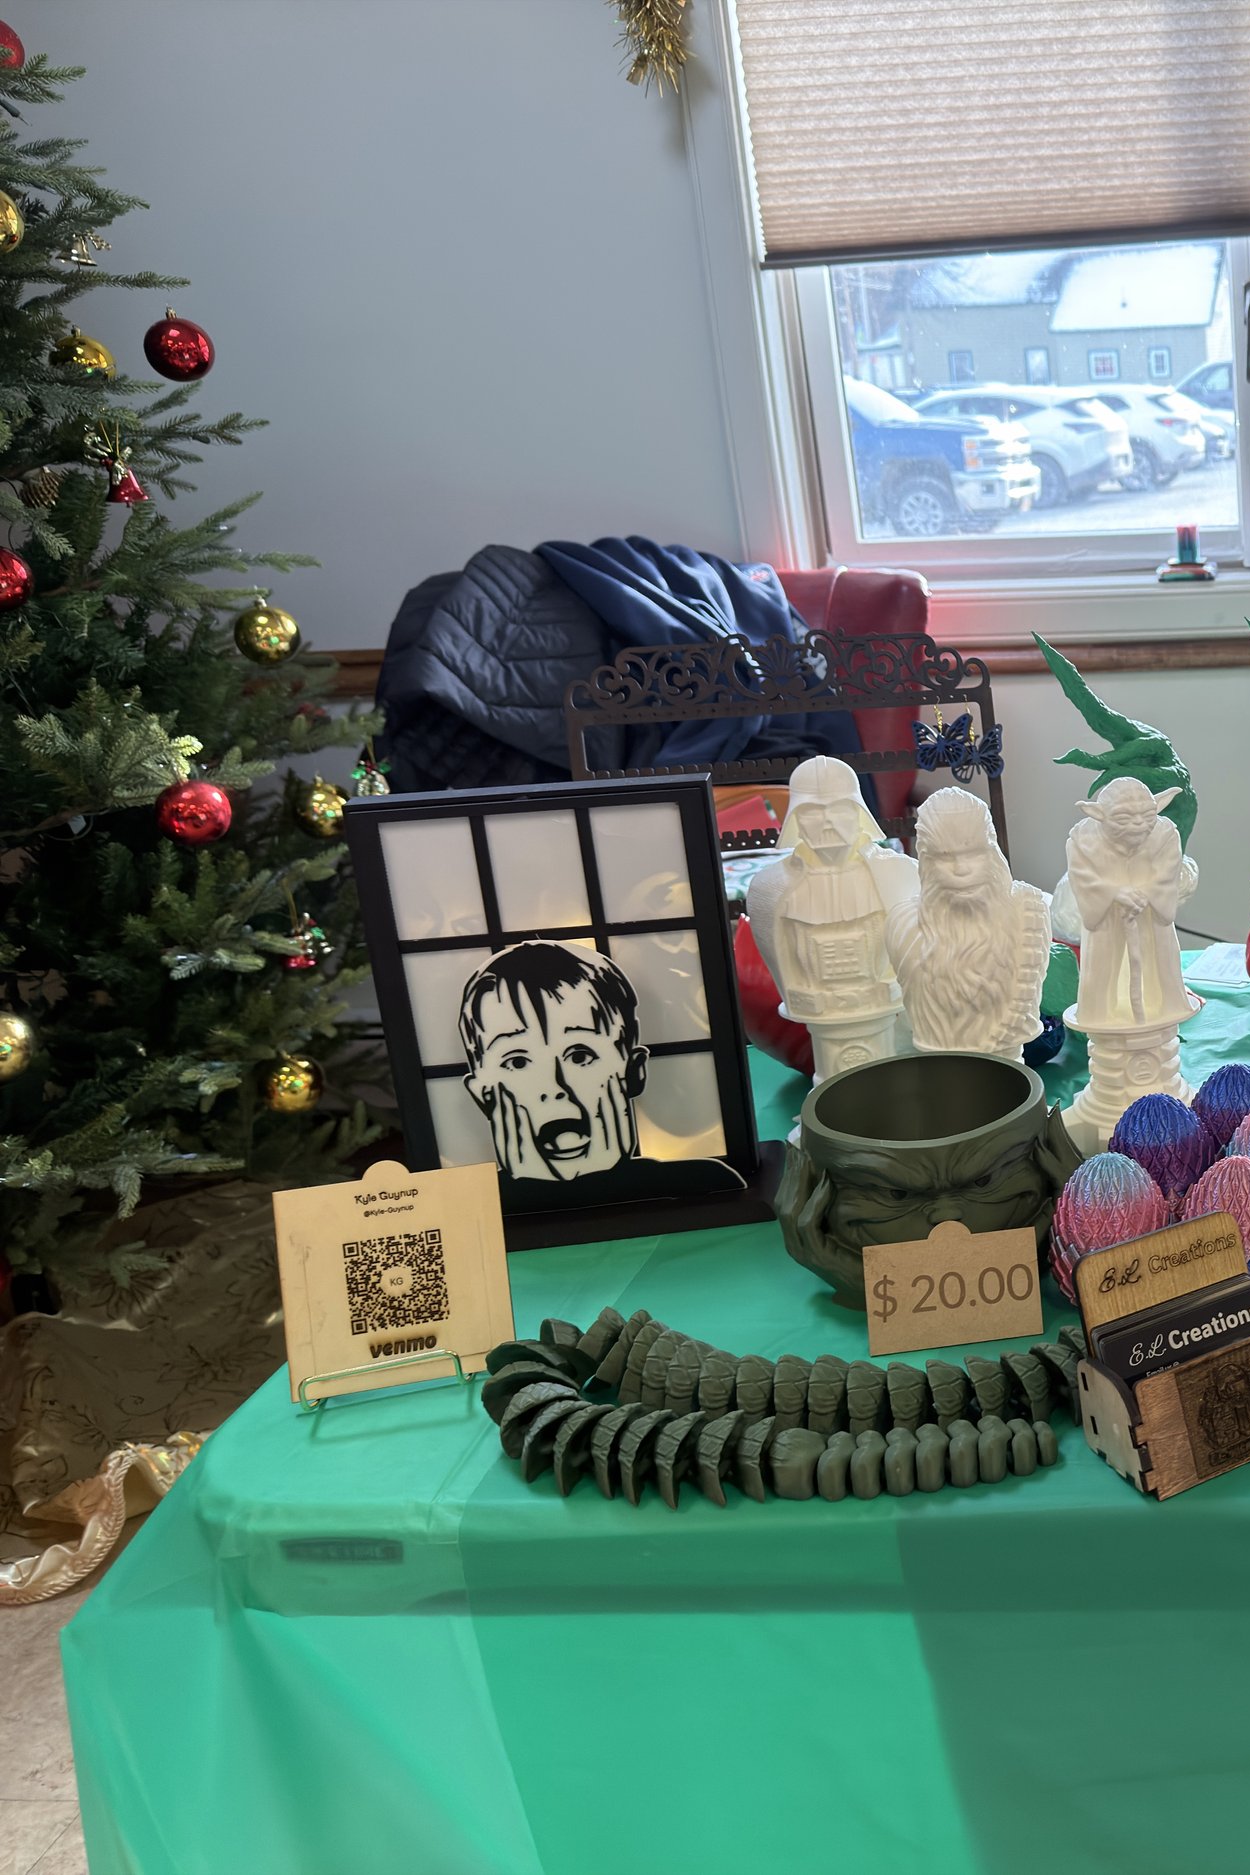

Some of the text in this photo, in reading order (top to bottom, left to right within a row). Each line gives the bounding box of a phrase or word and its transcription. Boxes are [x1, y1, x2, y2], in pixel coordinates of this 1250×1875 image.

[354, 1188, 419, 1205] Kyle Guynup
[1147, 1233, 1236, 1274] Creations
[389, 1277, 404, 1286] KG
[369, 1335, 437, 1359] venmo
